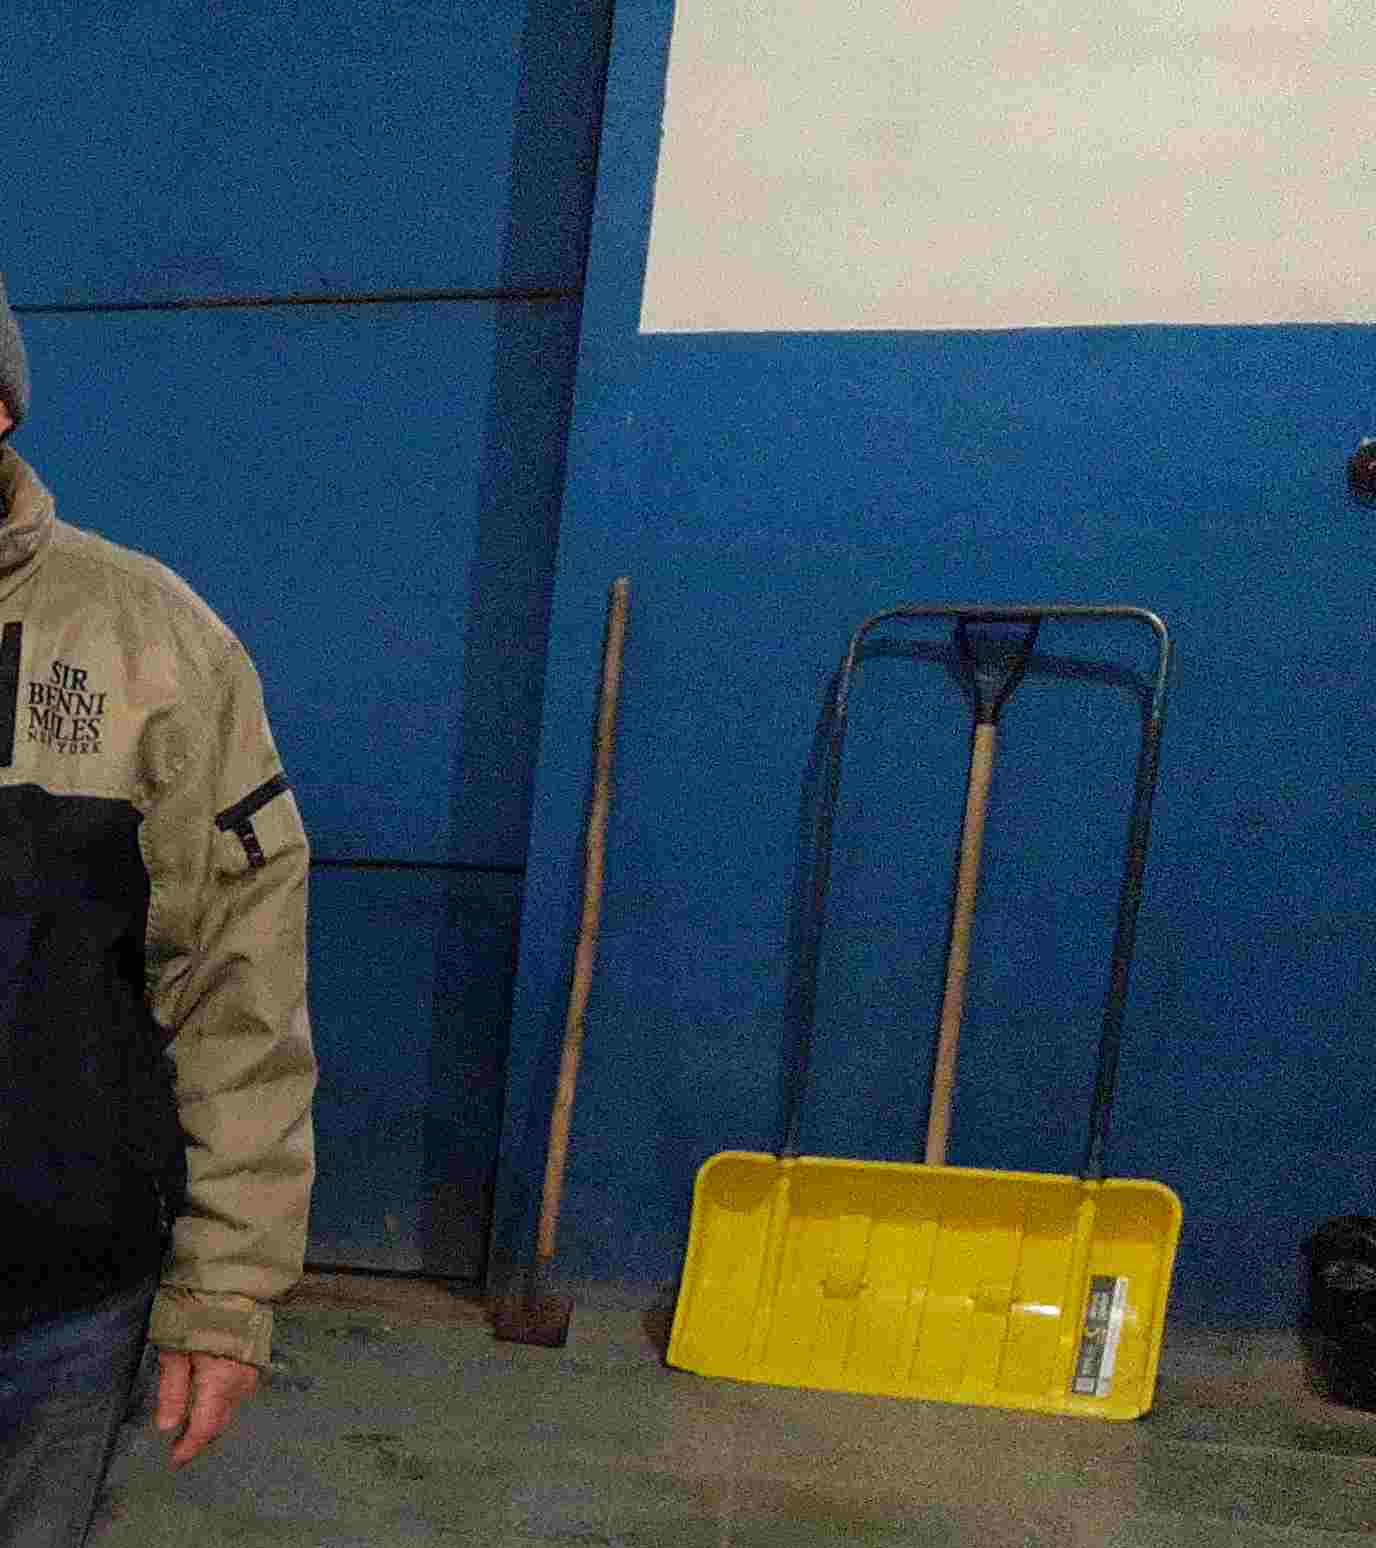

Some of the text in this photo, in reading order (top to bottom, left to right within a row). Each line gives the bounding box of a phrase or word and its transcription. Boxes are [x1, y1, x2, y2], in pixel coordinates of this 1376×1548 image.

[49, 660, 89, 693] SIR
[29, 682, 107, 716] BENNI
[27, 731, 53, 748] NE
[29, 706, 101, 742] MILES
